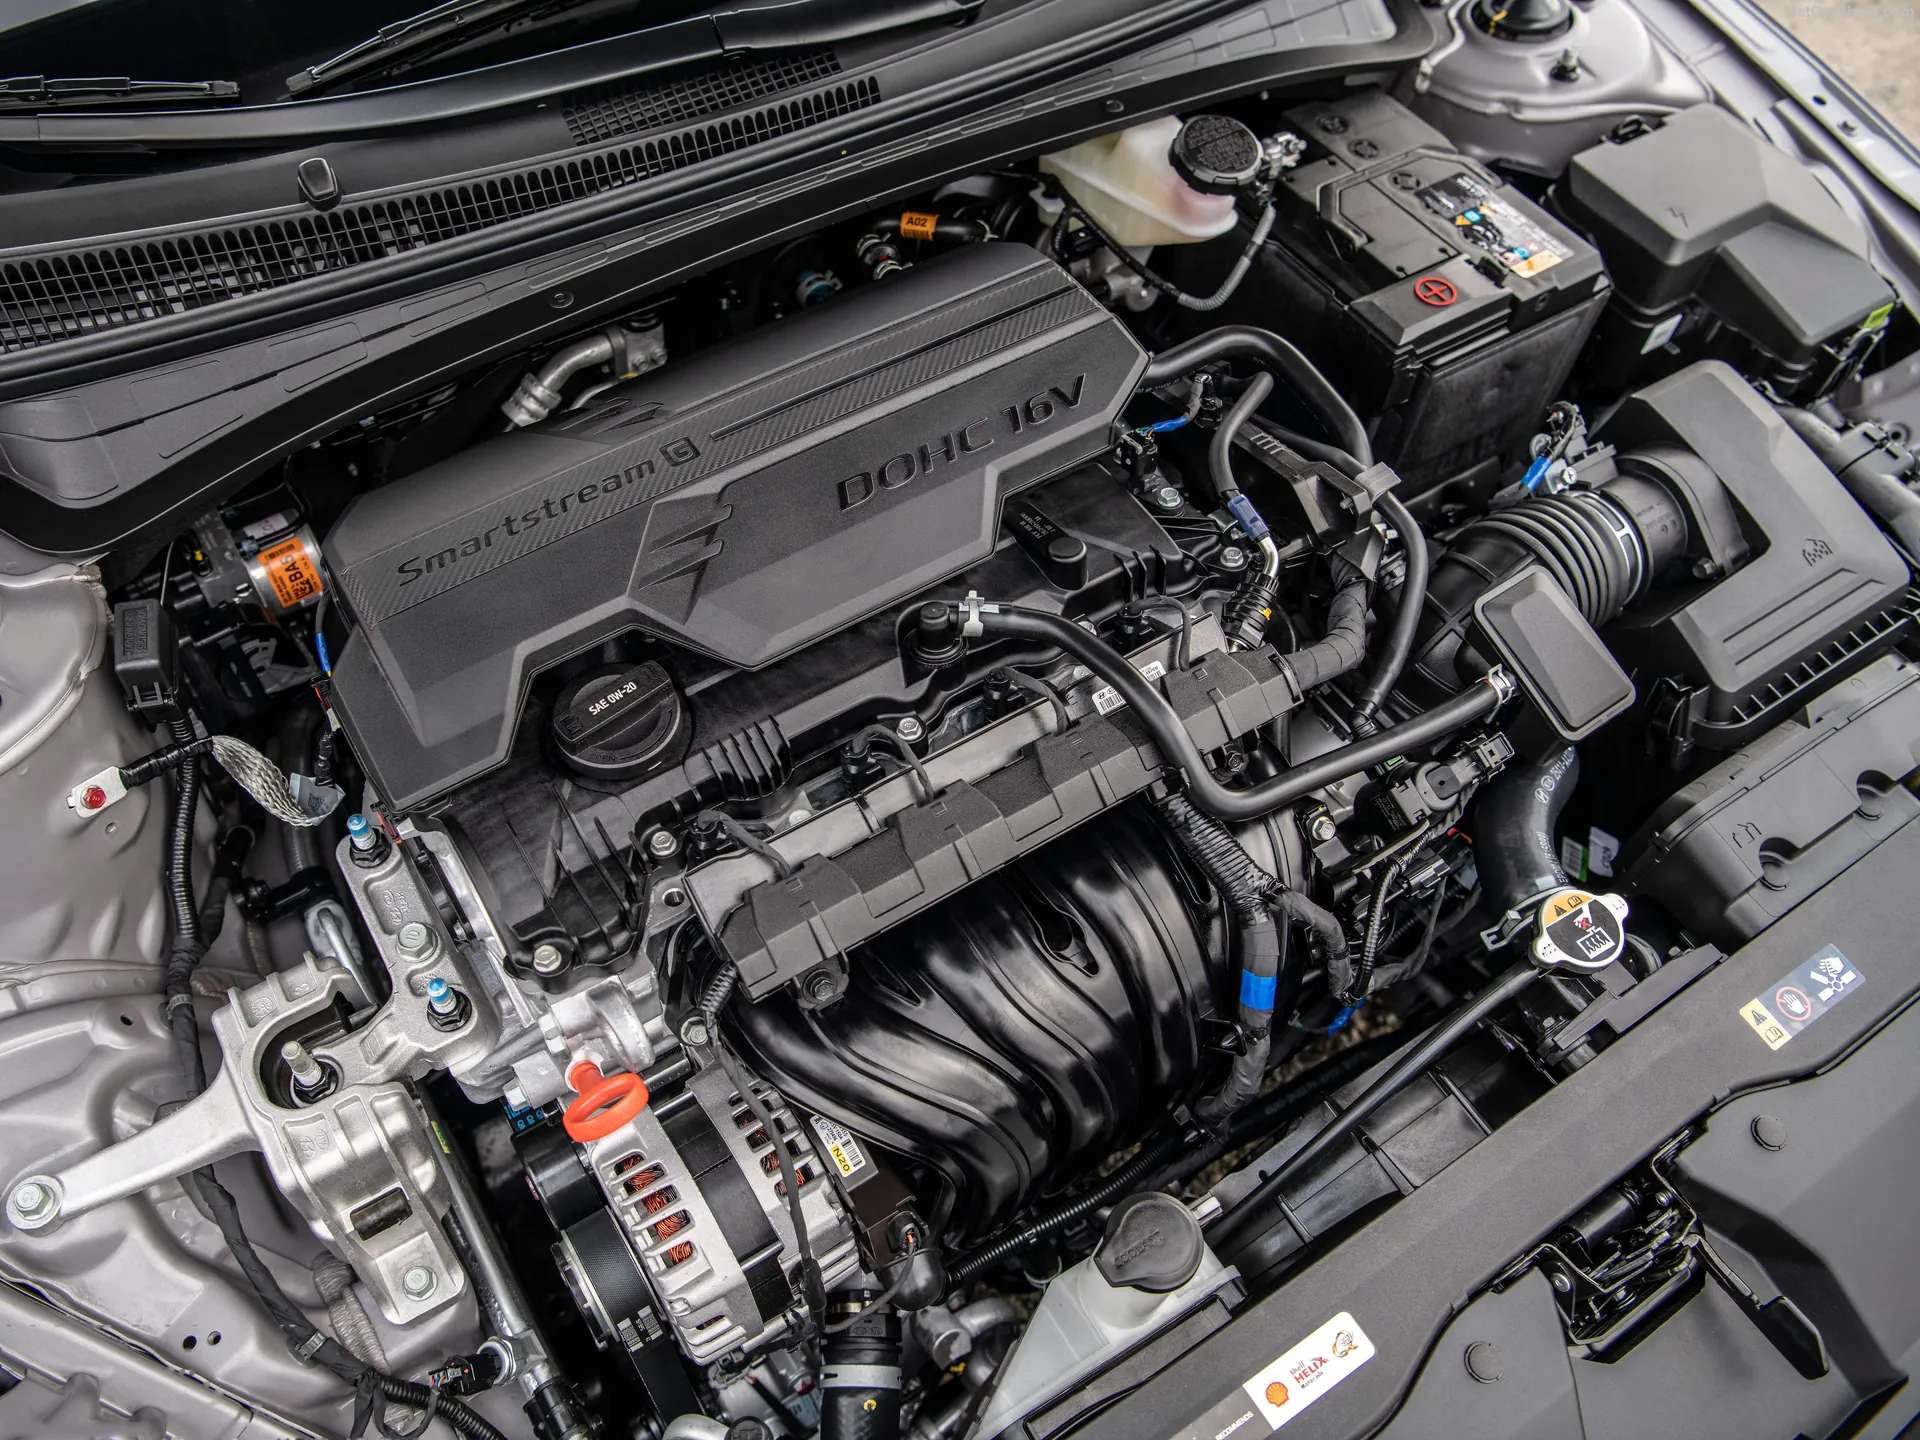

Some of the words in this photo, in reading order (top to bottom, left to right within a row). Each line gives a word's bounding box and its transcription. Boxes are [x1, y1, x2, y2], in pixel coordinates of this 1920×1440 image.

[906, 216, 927, 227] A02
[836, 416, 994, 512] DOHC
[1002, 373, 1087, 435] 16V
[396, 459, 656, 588] Smartstream
[280, 553, 304, 581] BA5
[588, 695, 610, 716] SAE
[606, 681, 637, 707] 0W-20
[833, 1147, 850, 1172] N20
[1112, 1228, 1163, 1269] COOLANT
[1289, 1360, 1305, 1376] Shell
[1293, 1357, 1326, 1384] HELIX
[1214, 1410, 1254, 1440] RECOMMENDS
